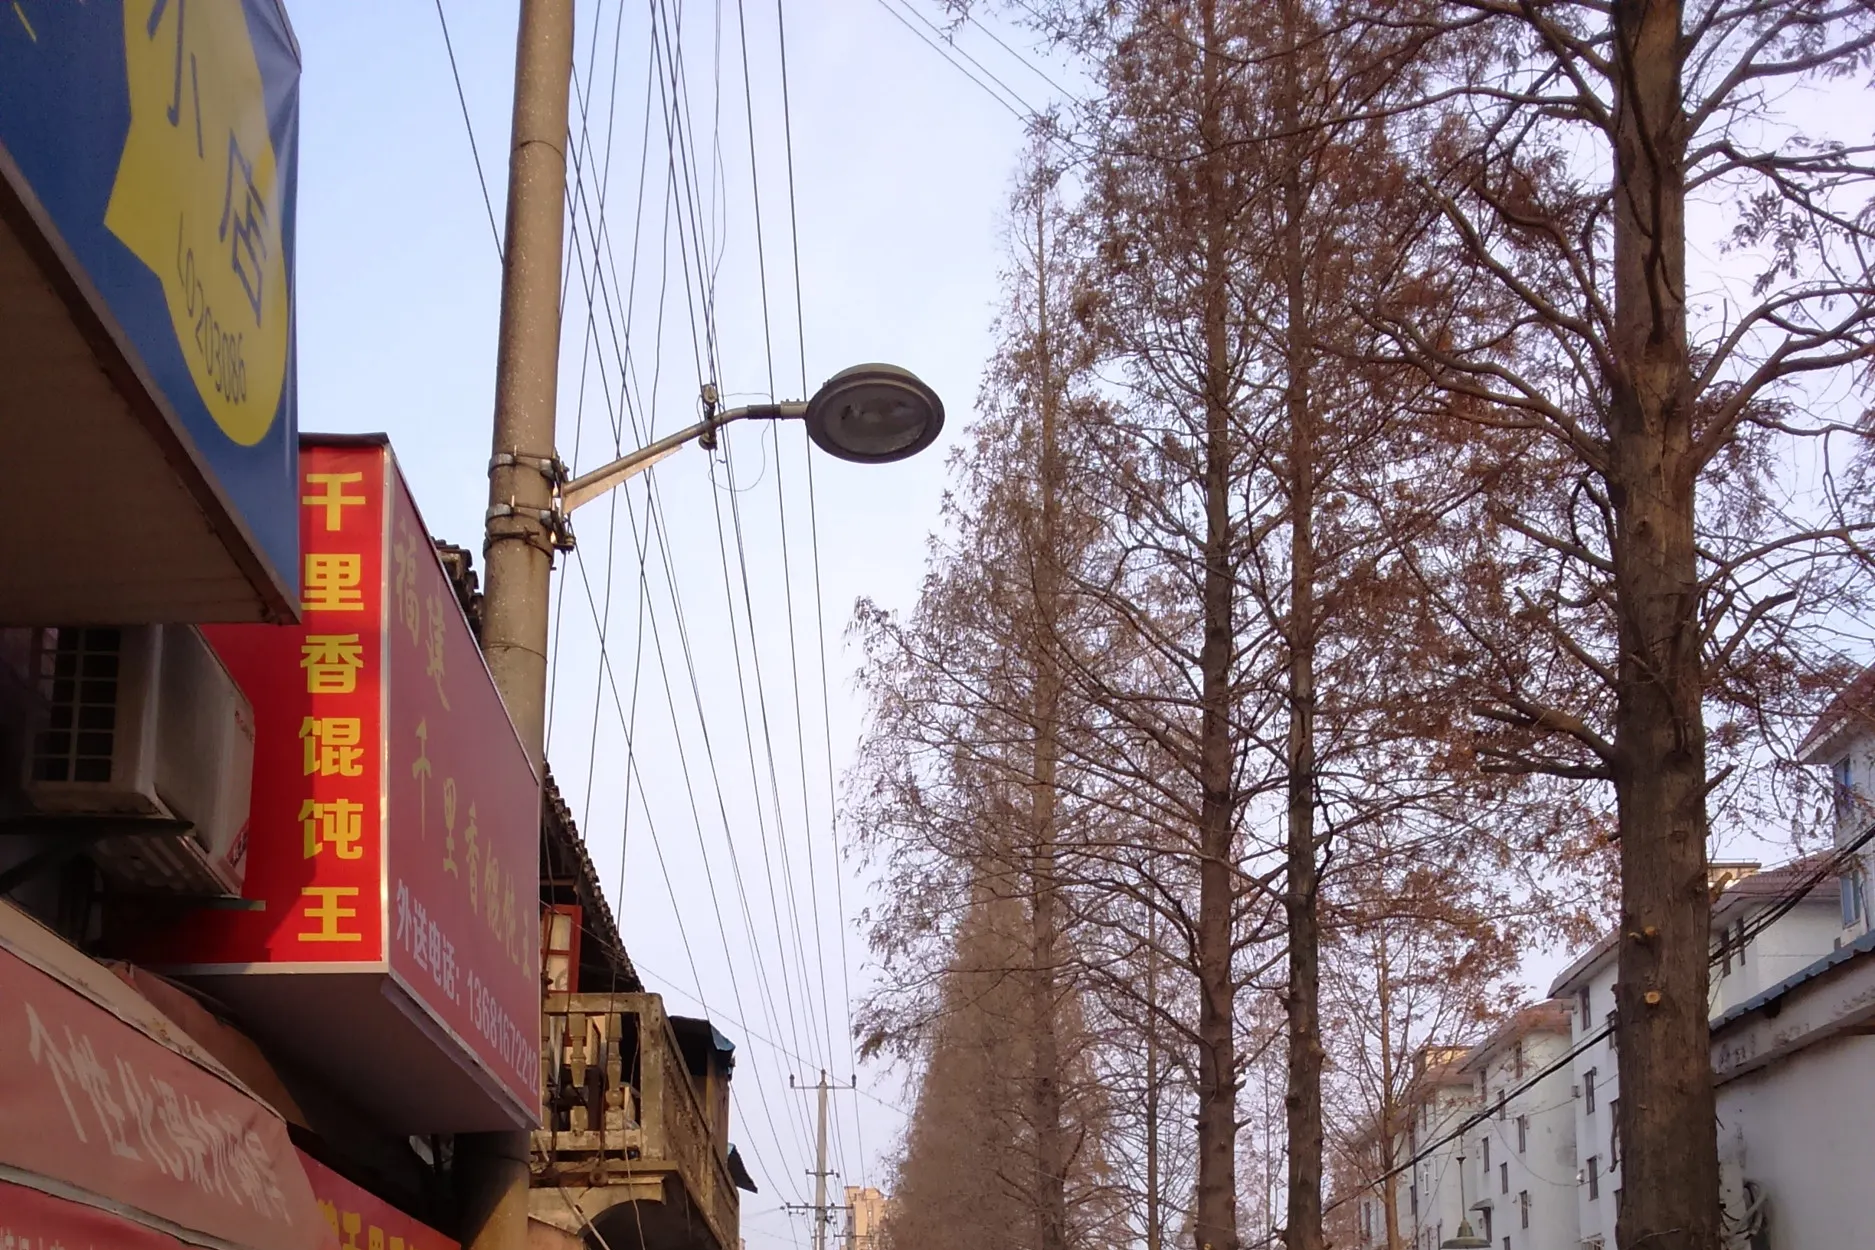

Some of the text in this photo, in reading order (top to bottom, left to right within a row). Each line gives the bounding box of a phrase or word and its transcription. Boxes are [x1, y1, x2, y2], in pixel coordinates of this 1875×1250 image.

[298, 472, 367, 943] 千里香馄饨王
[393, 516, 450, 712] 福建
[411, 717, 532, 981] 千里香馄饨王
